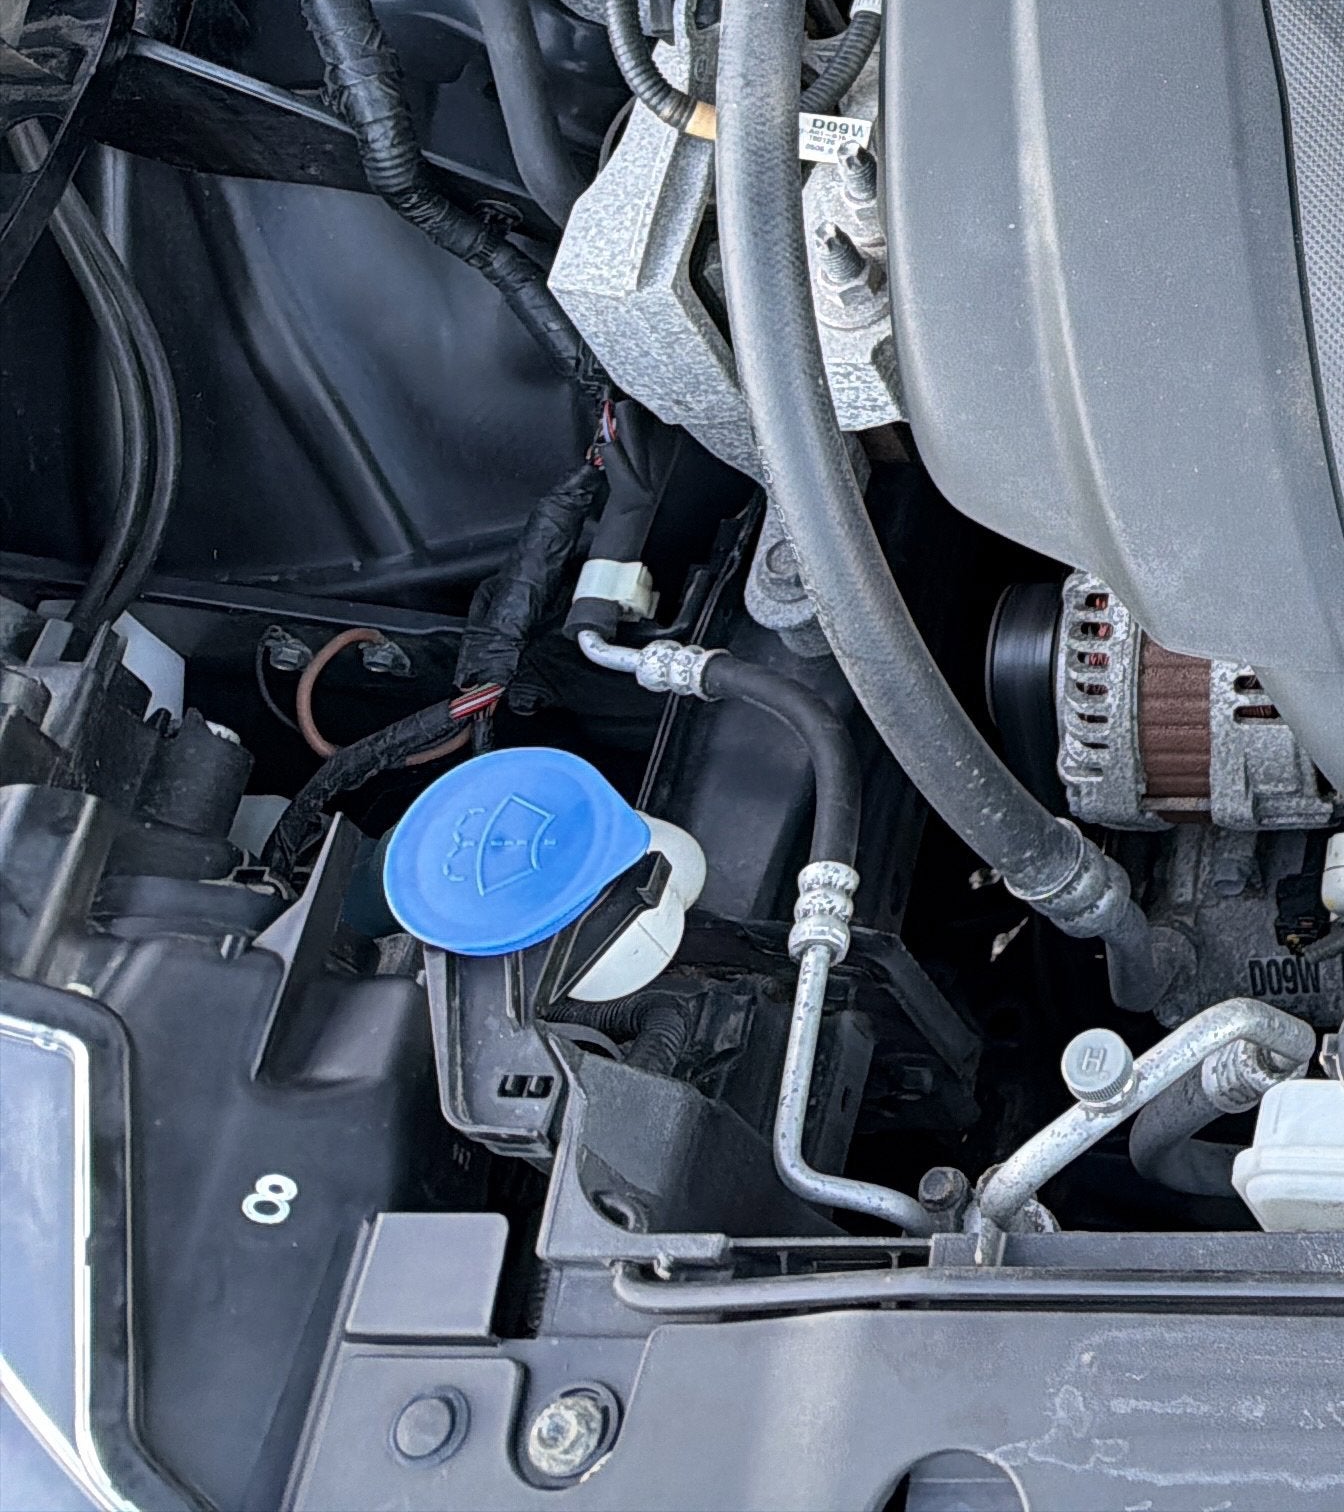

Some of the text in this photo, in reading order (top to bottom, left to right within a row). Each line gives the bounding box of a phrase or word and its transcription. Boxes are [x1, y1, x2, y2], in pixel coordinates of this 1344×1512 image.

[1249, 957, 1321, 997] D09W
[1081, 1047, 1107, 1072] H
[241, 1173, 298, 1225] 8
